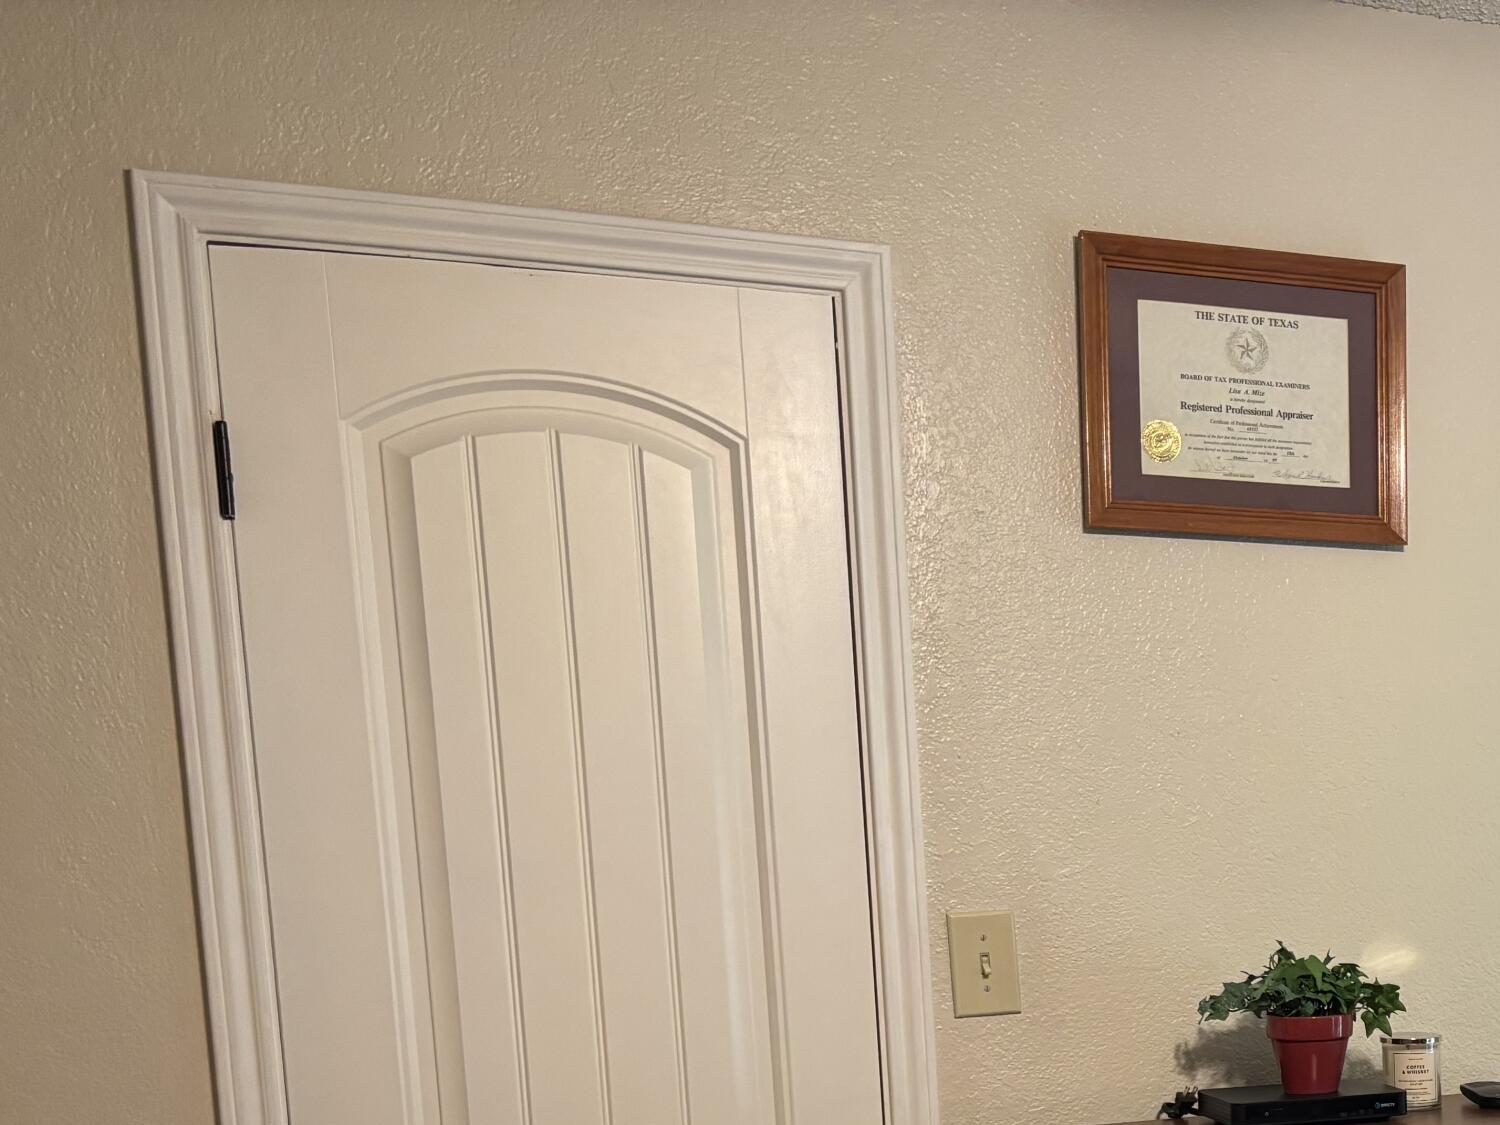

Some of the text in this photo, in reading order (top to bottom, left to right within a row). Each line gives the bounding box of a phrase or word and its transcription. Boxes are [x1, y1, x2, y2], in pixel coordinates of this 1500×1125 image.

[1194, 310, 1299, 329] THE STATE OF TEXAS
[1228, 377, 1274, 388] PROFESSIONAL
[1276, 382, 1310, 390] EXAMINERS
[1180, 401, 1314, 420] Registered Professional Appraiser
